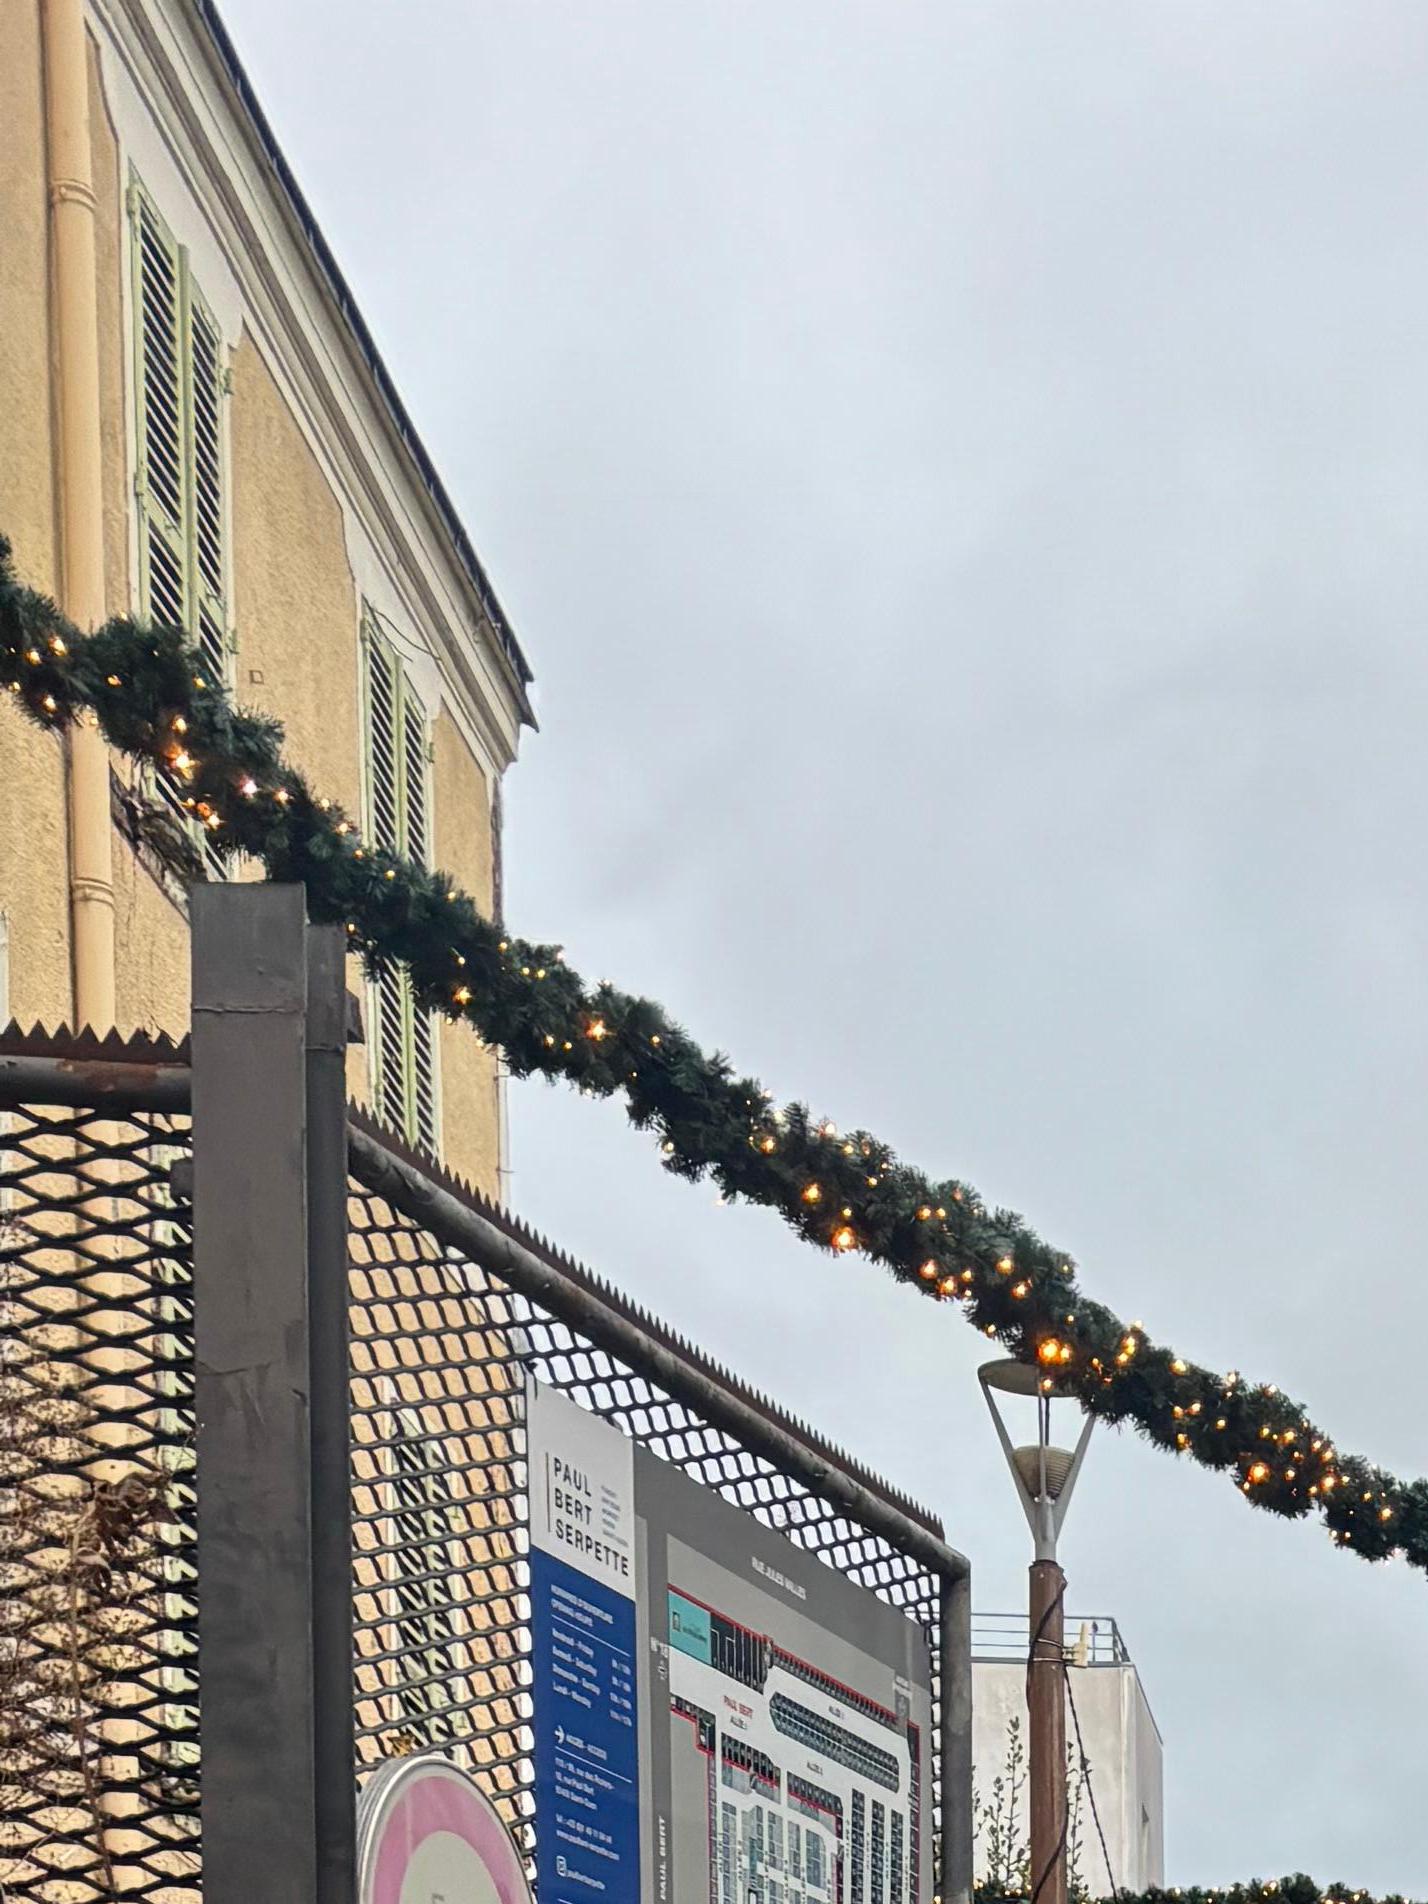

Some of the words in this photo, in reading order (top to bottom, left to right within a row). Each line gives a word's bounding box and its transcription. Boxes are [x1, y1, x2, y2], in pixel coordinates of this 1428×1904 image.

[553, 1457, 592, 1498] PAUL
[554, 1487, 592, 1525] BERT
[555, 1519, 629, 1577] SERPETTE
